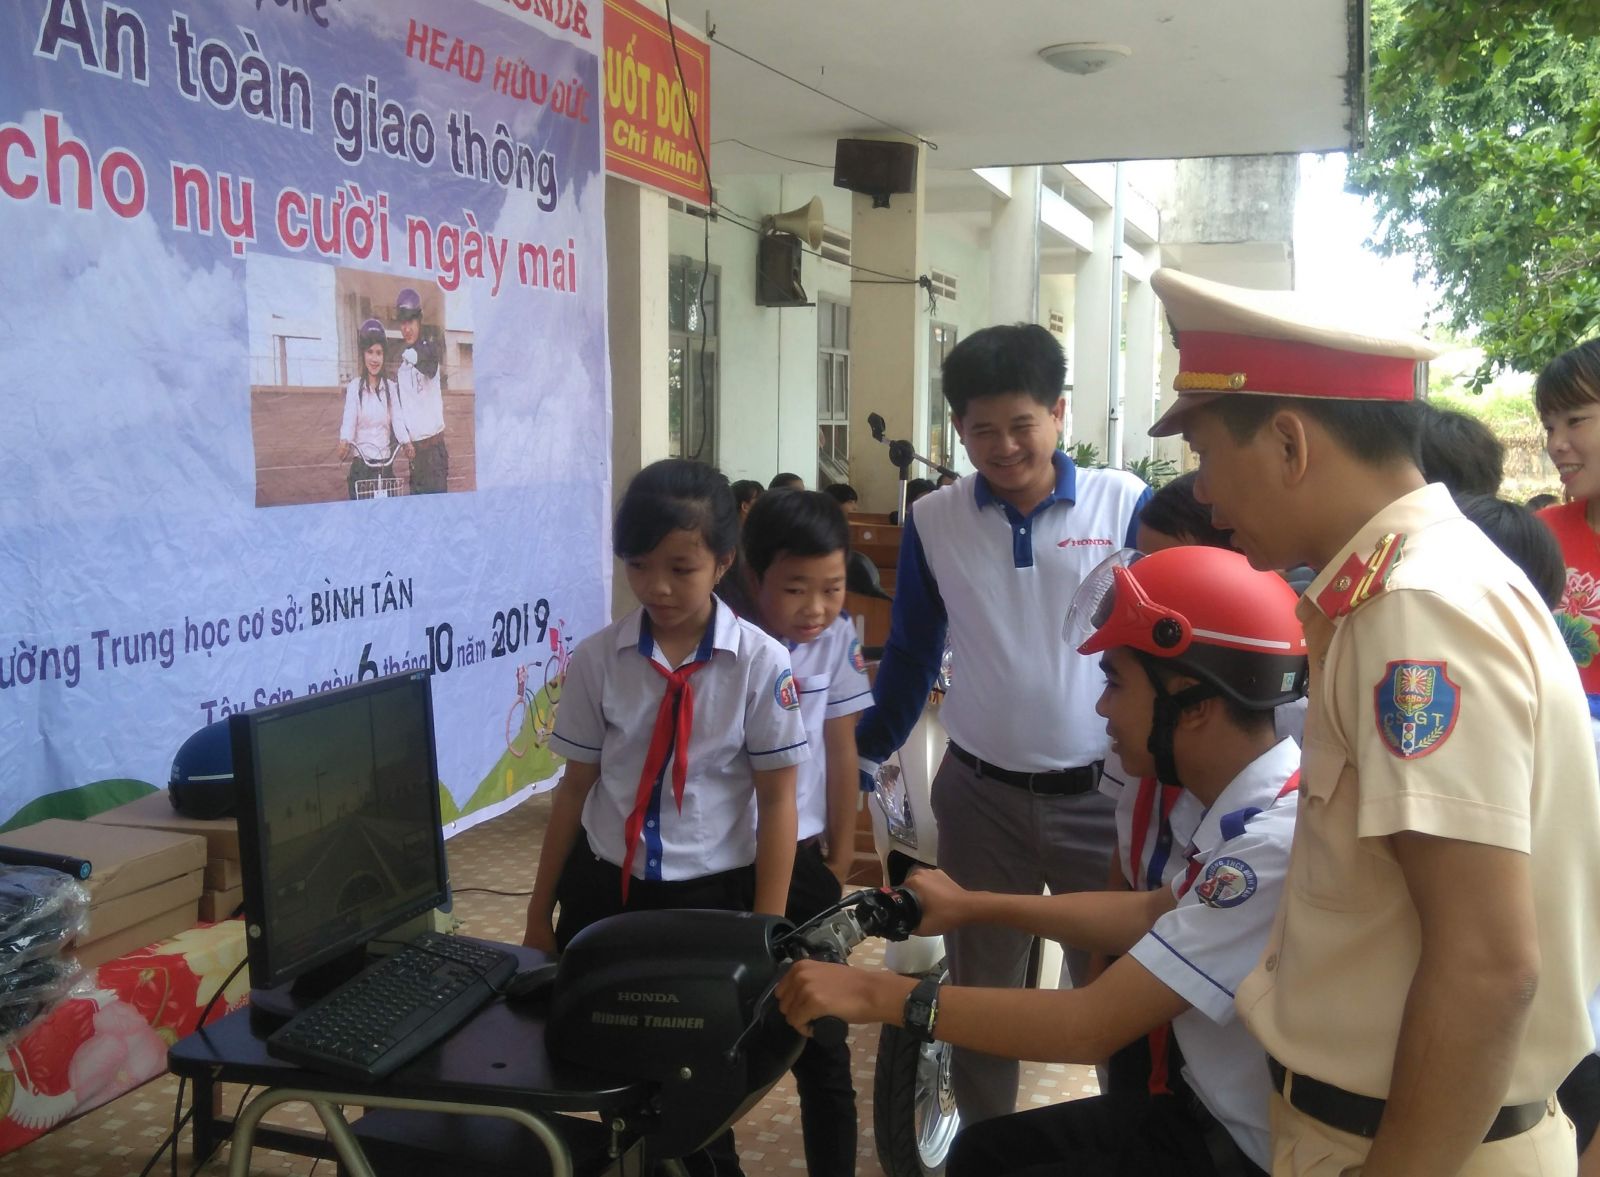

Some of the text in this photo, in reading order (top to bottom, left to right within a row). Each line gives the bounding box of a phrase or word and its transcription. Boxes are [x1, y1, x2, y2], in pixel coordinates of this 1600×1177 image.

[504, 0, 592, 40] NDA
[405, 19, 484, 84] HEAD
[493, 56, 548, 106] HỮU
[604, 34, 651, 120] UỐT
[37, 0, 557, 211] An toàn giao thông
[613, 119, 698, 175] Chí Minh
[0, 114, 577, 298] cho nụ cười ngày mai
[1071, 539, 1113, 547] HONDA
[91, 629, 175, 670] Trung
[185, 616, 230, 658] học
[238, 607, 265, 643] cơ
[271, 594, 304, 637] sở:
[311, 577, 364, 626] BÌNH
[371, 571, 413, 614] TÂN
[358, 642, 379, 682] 6
[425, 622, 454, 675] 10
[457, 636, 486, 668] năm
[491, 598, 550, 658] 2019
[591, 1010, 705, 1029] RIDING TRAINER
[617, 991, 680, 1004] HONDA
